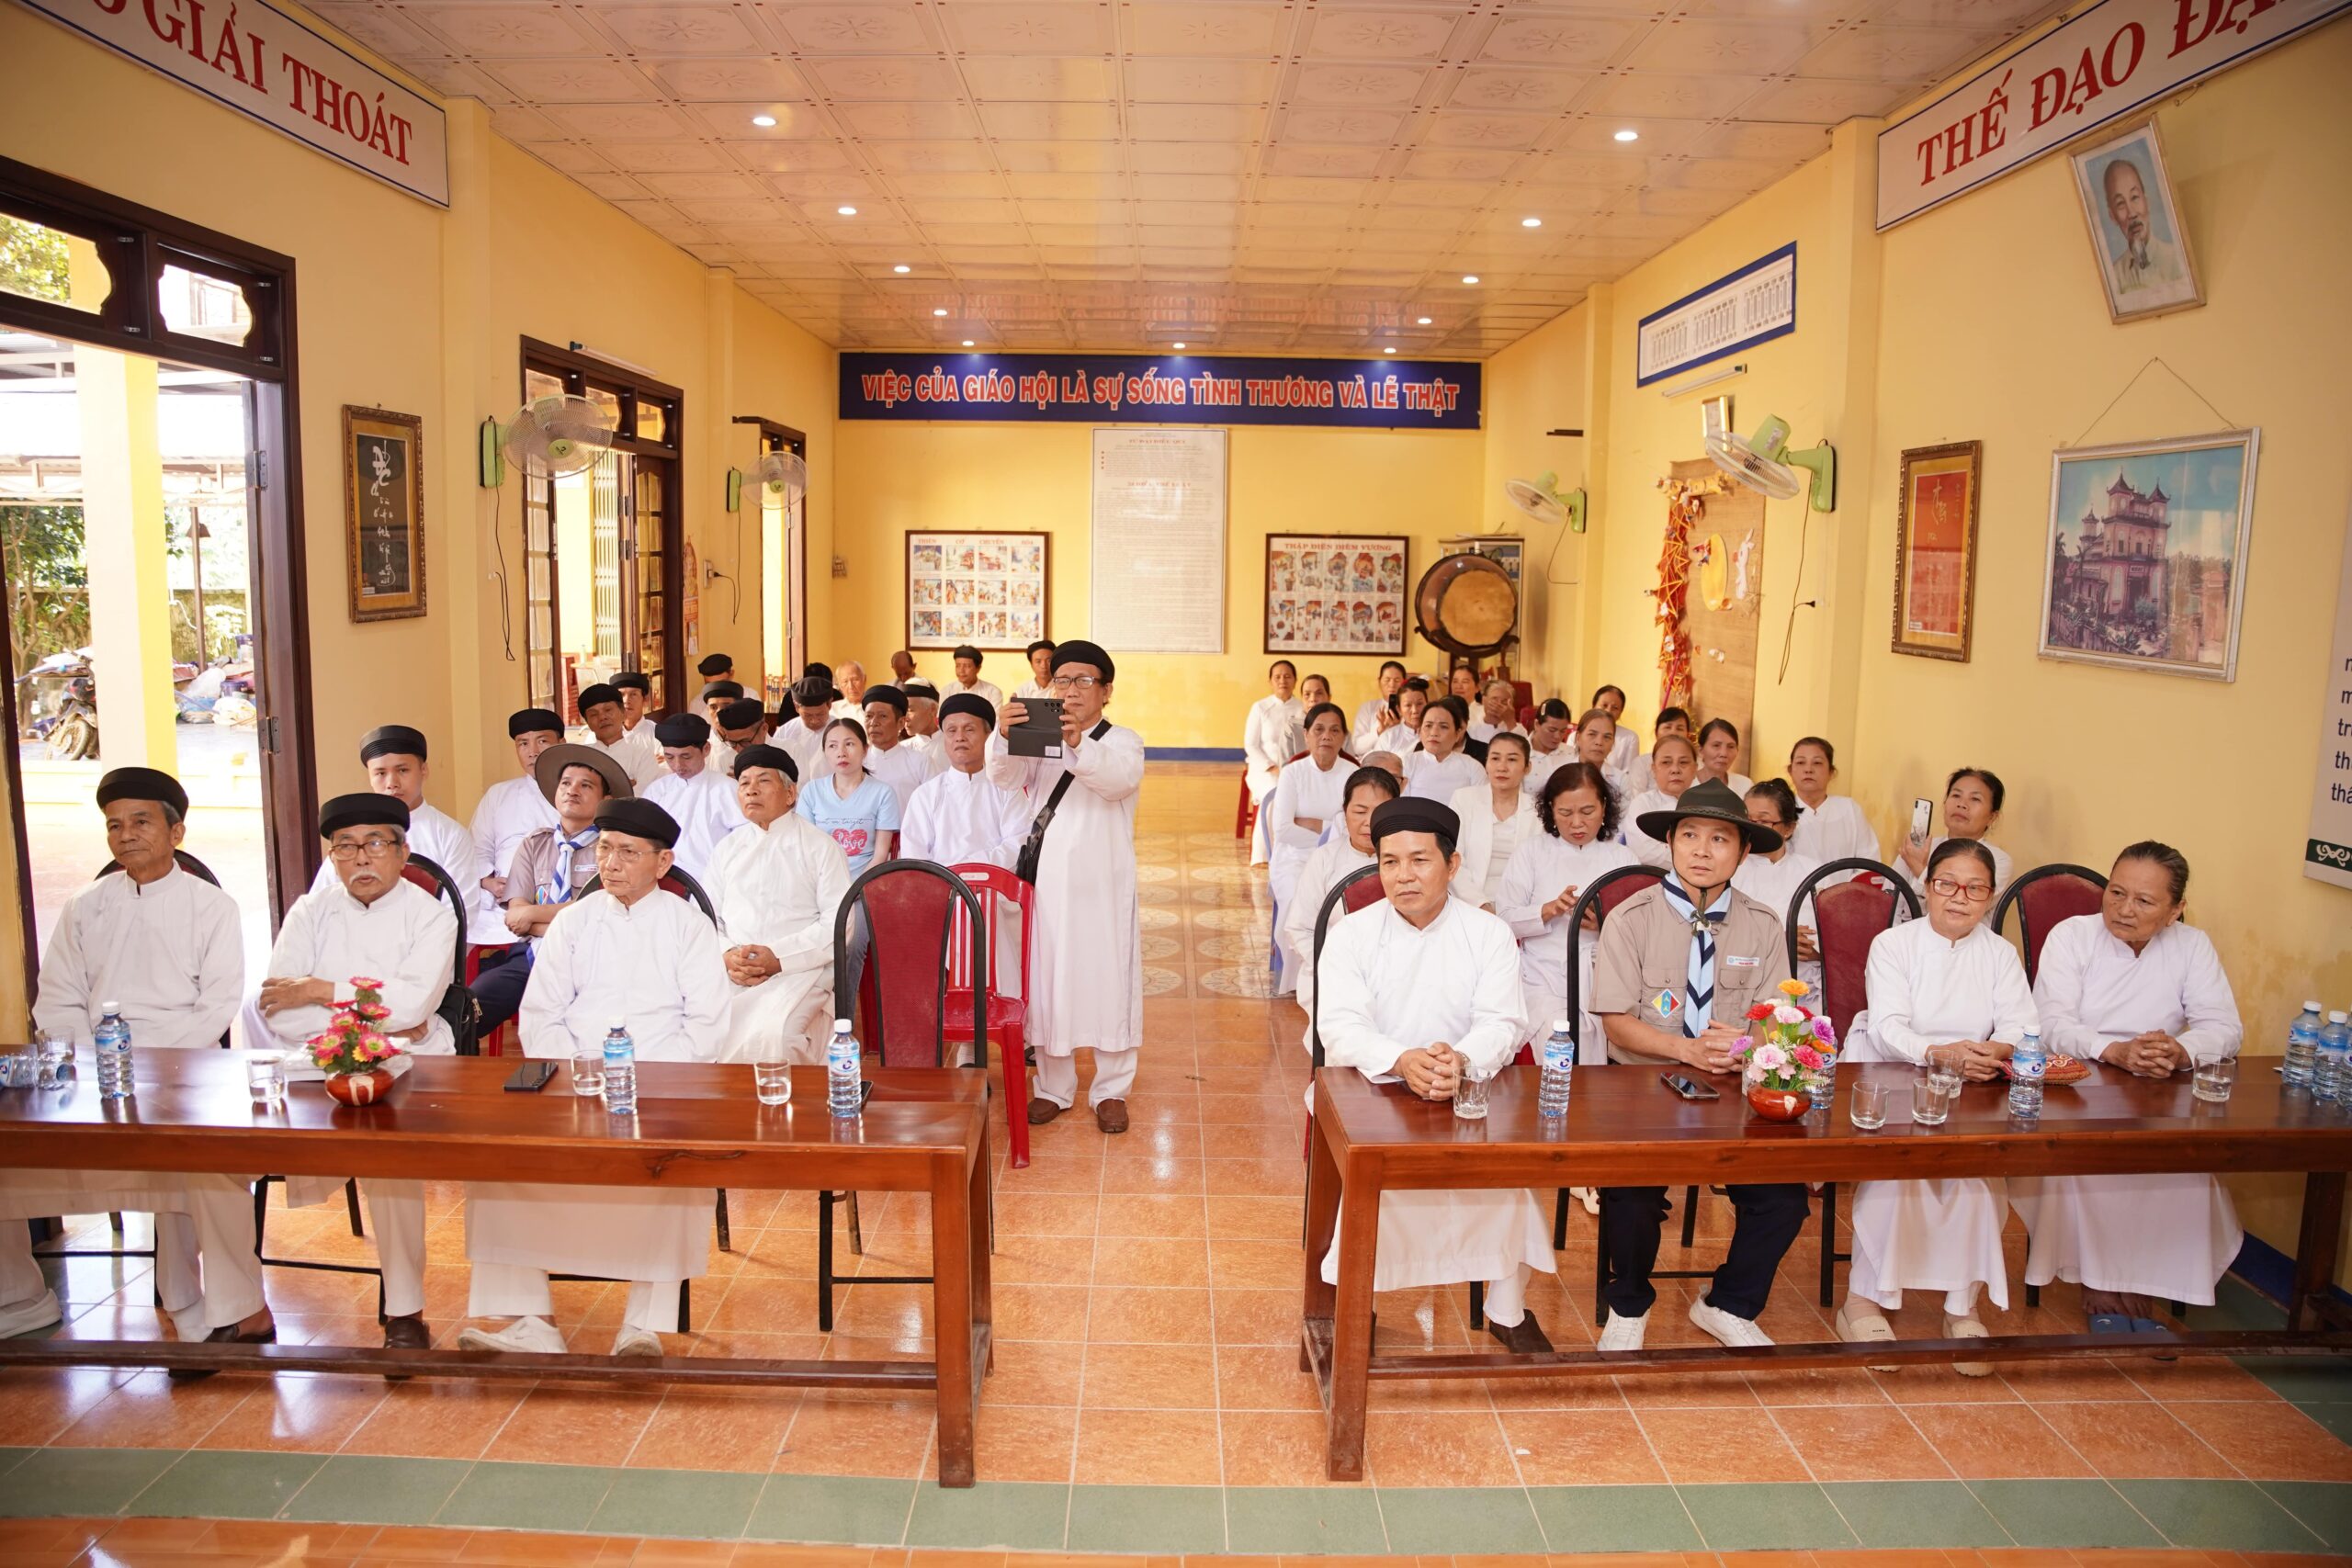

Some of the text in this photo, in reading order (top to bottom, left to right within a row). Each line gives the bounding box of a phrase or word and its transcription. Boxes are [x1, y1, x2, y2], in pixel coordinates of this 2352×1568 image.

[283, 52, 413, 166] THOÁT
[1917, 69, 2014, 186] THẾ
[2027, 21, 2145, 132] ĐẠO
[862, 366, 1460, 418] VIỆC CỦA GIÁO HỘI LÀ SỰ SỐNG TÌNH THƯƠNG VÀ LẼ THẬT
[2338, 718, 2352, 737] tr
[2335, 750, 2352, 770] th
[839, 832, 865, 850] love
